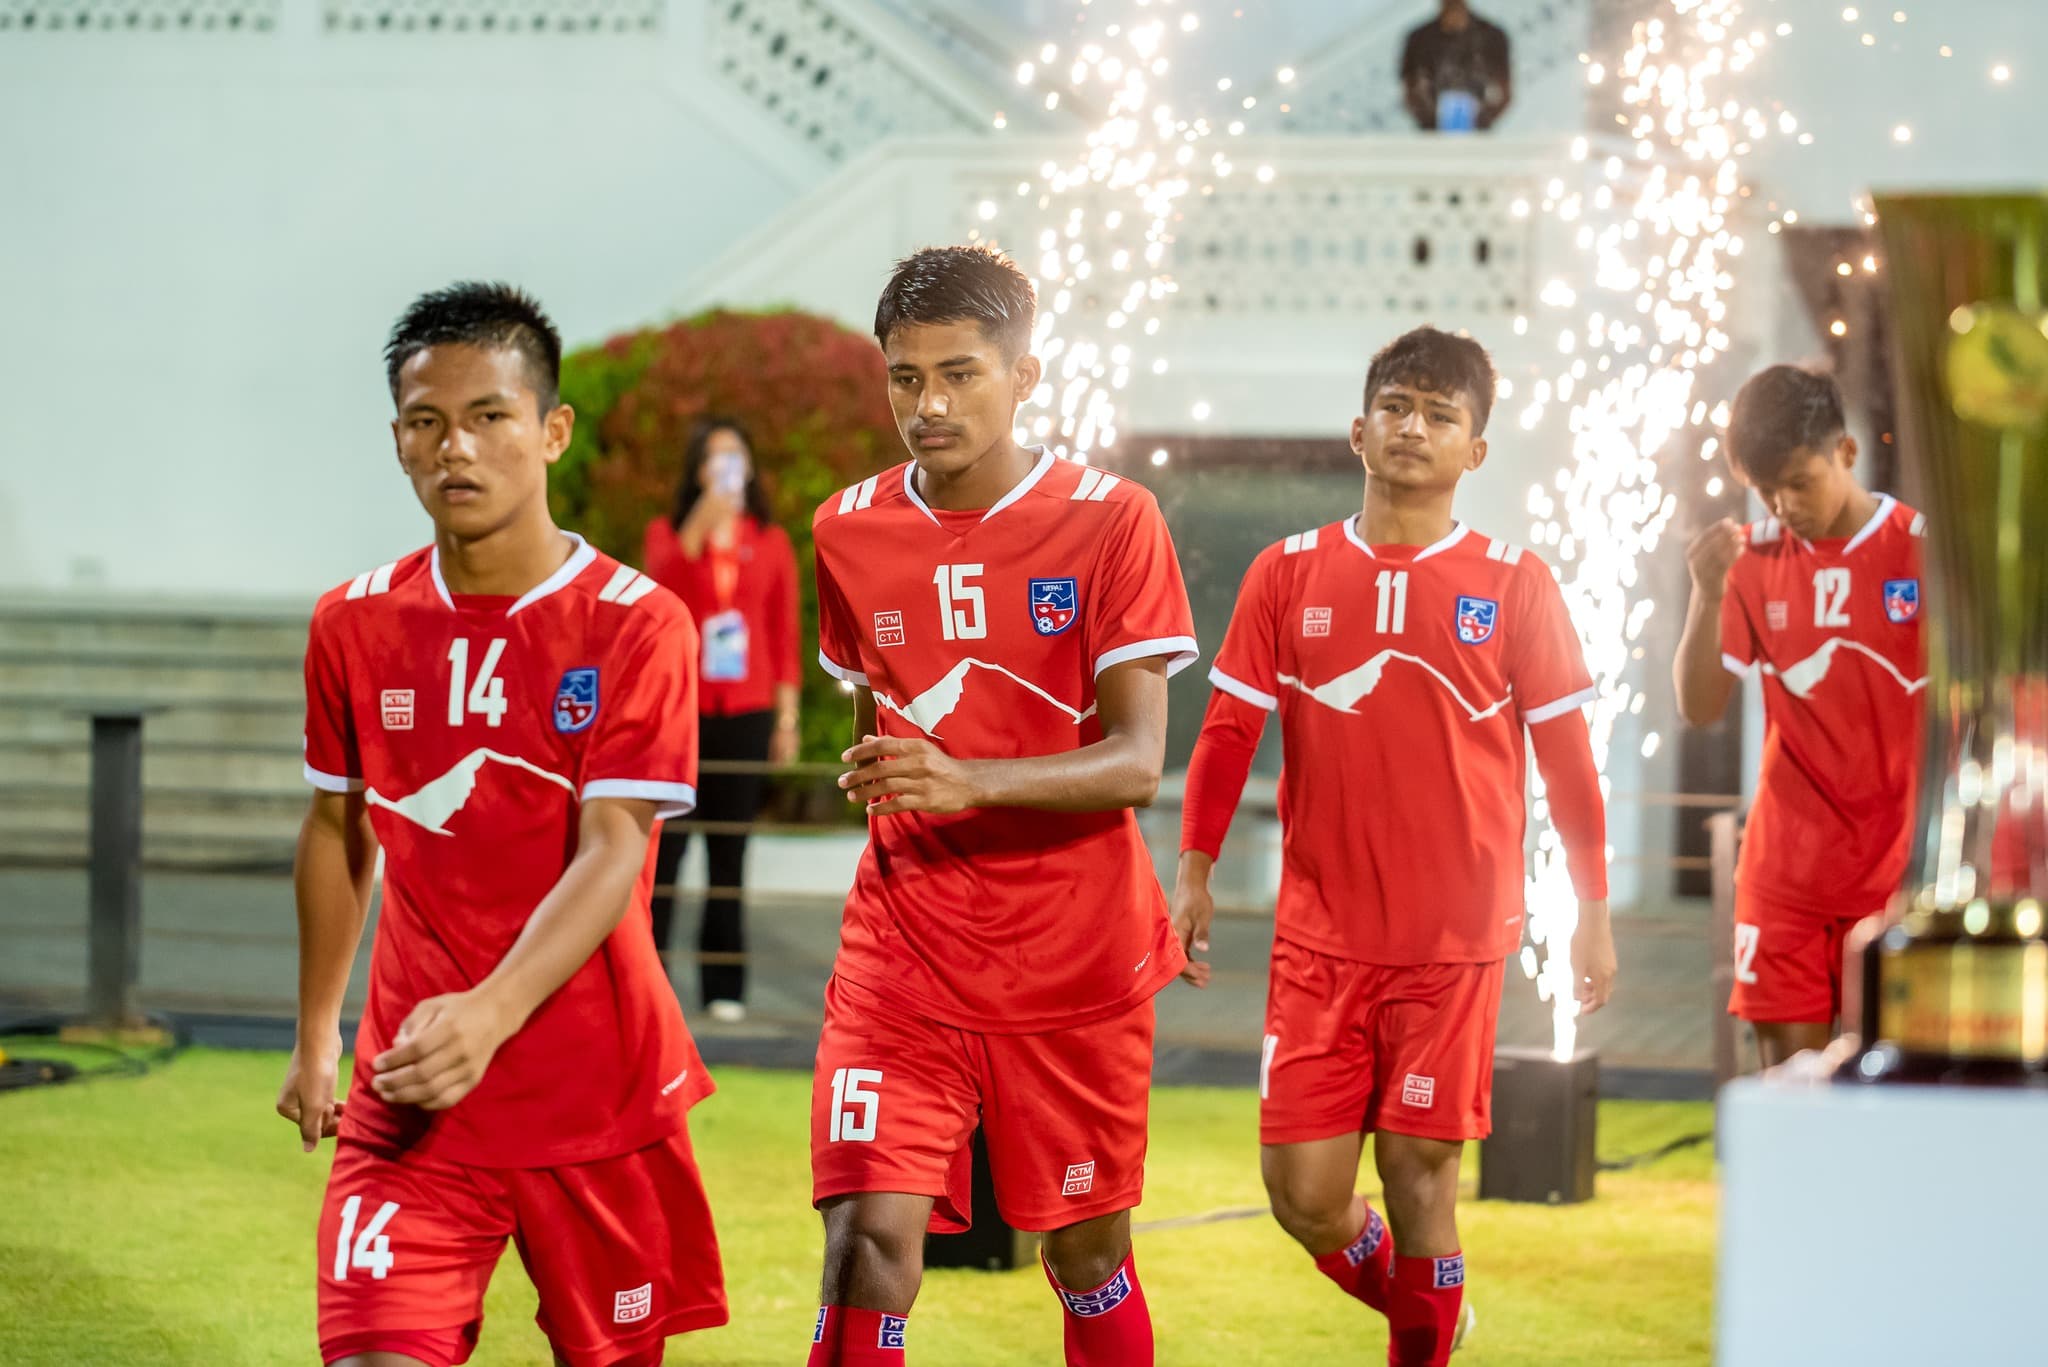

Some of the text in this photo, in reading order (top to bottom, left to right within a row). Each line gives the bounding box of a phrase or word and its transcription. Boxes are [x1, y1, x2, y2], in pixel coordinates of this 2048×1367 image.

[1042, 584, 1064, 592] NEPAL
[1812, 567, 1851, 628] 12
[932, 563, 987, 641] 15
[1375, 569, 1409, 635] 11
[877, 615, 899, 626] KTM
[879, 632, 900, 642] CTY
[447, 637, 508, 728] 14
[830, 1067, 883, 1143] 15
[1070, 1166, 1091, 1177] KTM
[1067, 1181, 1088, 1192] CTY
[333, 1195, 401, 1282] 14
[620, 1289, 648, 1304] KTM
[1074, 1286, 1124, 1314] CTY
[619, 1303, 647, 1319] CTY
